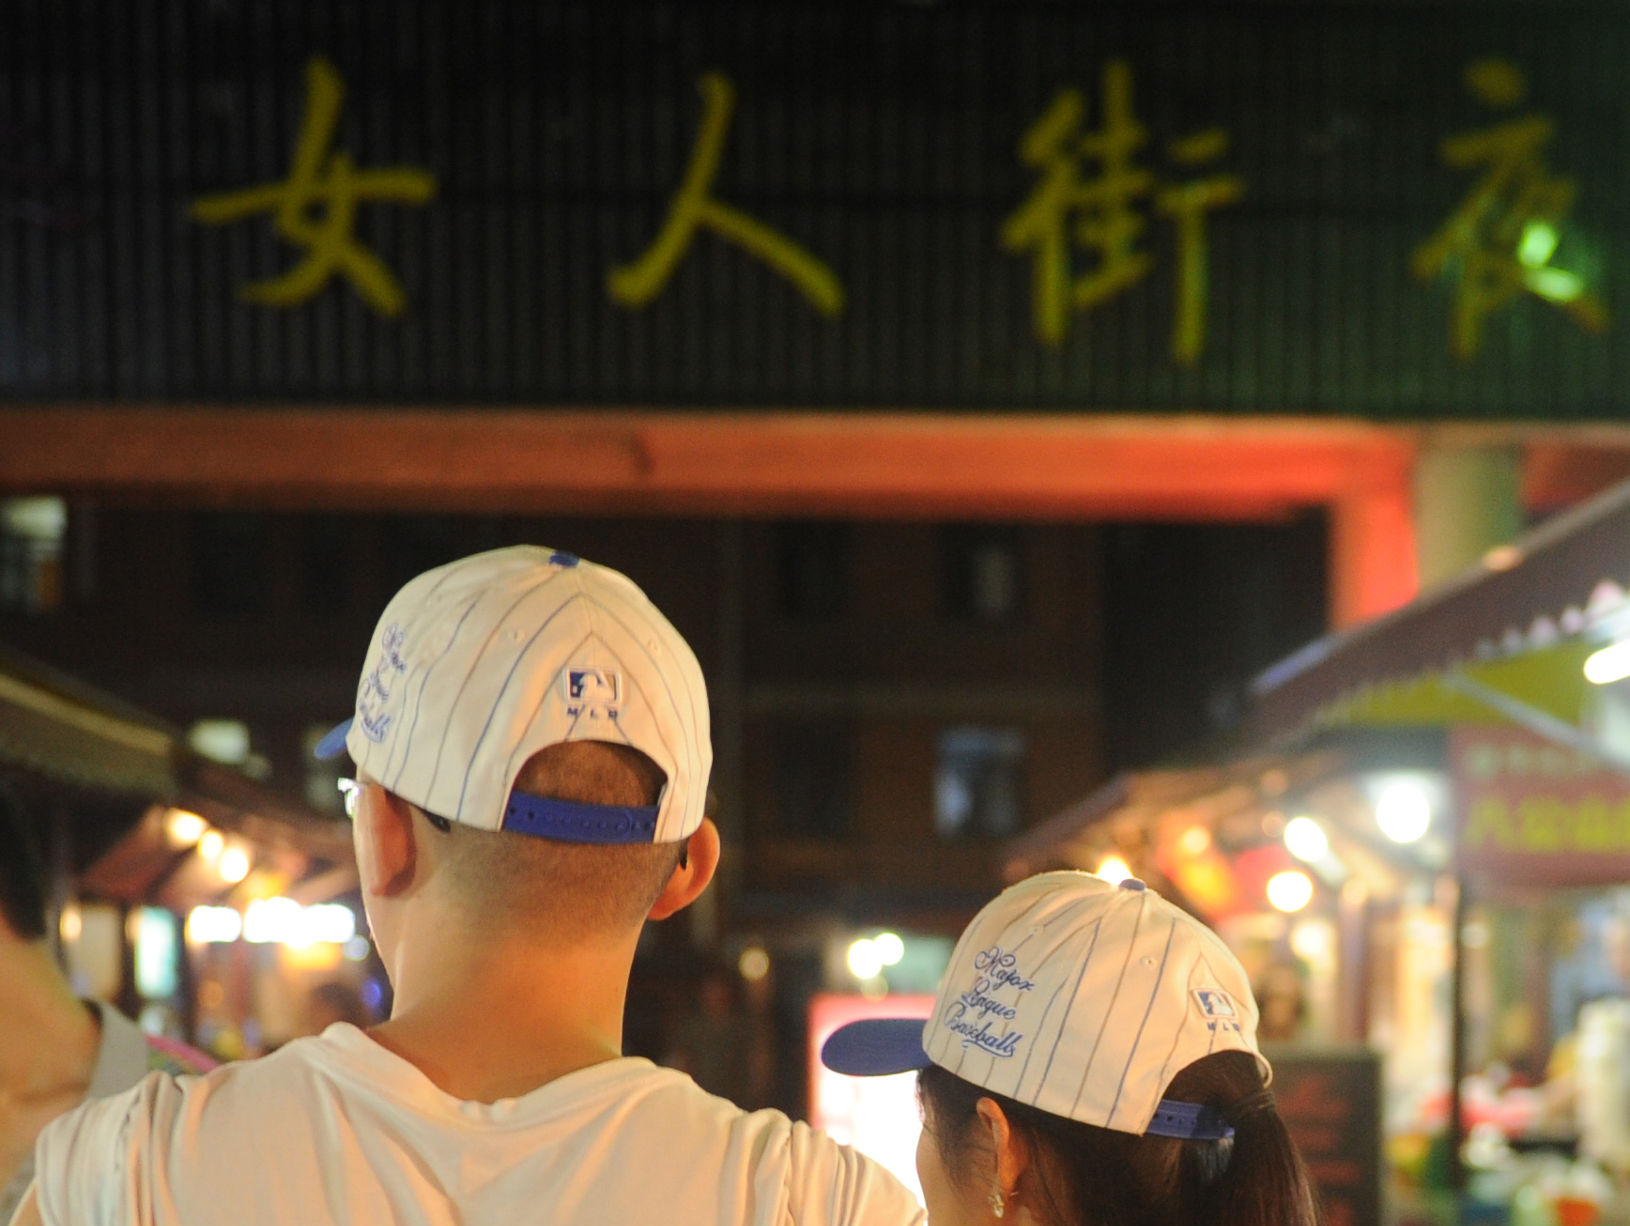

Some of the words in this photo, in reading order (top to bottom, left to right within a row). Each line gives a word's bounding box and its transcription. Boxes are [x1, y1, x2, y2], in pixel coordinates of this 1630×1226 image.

[974, 946, 1034, 991] Major
[961, 976, 1016, 1019] League
[944, 1001, 1023, 1057] Baseball
